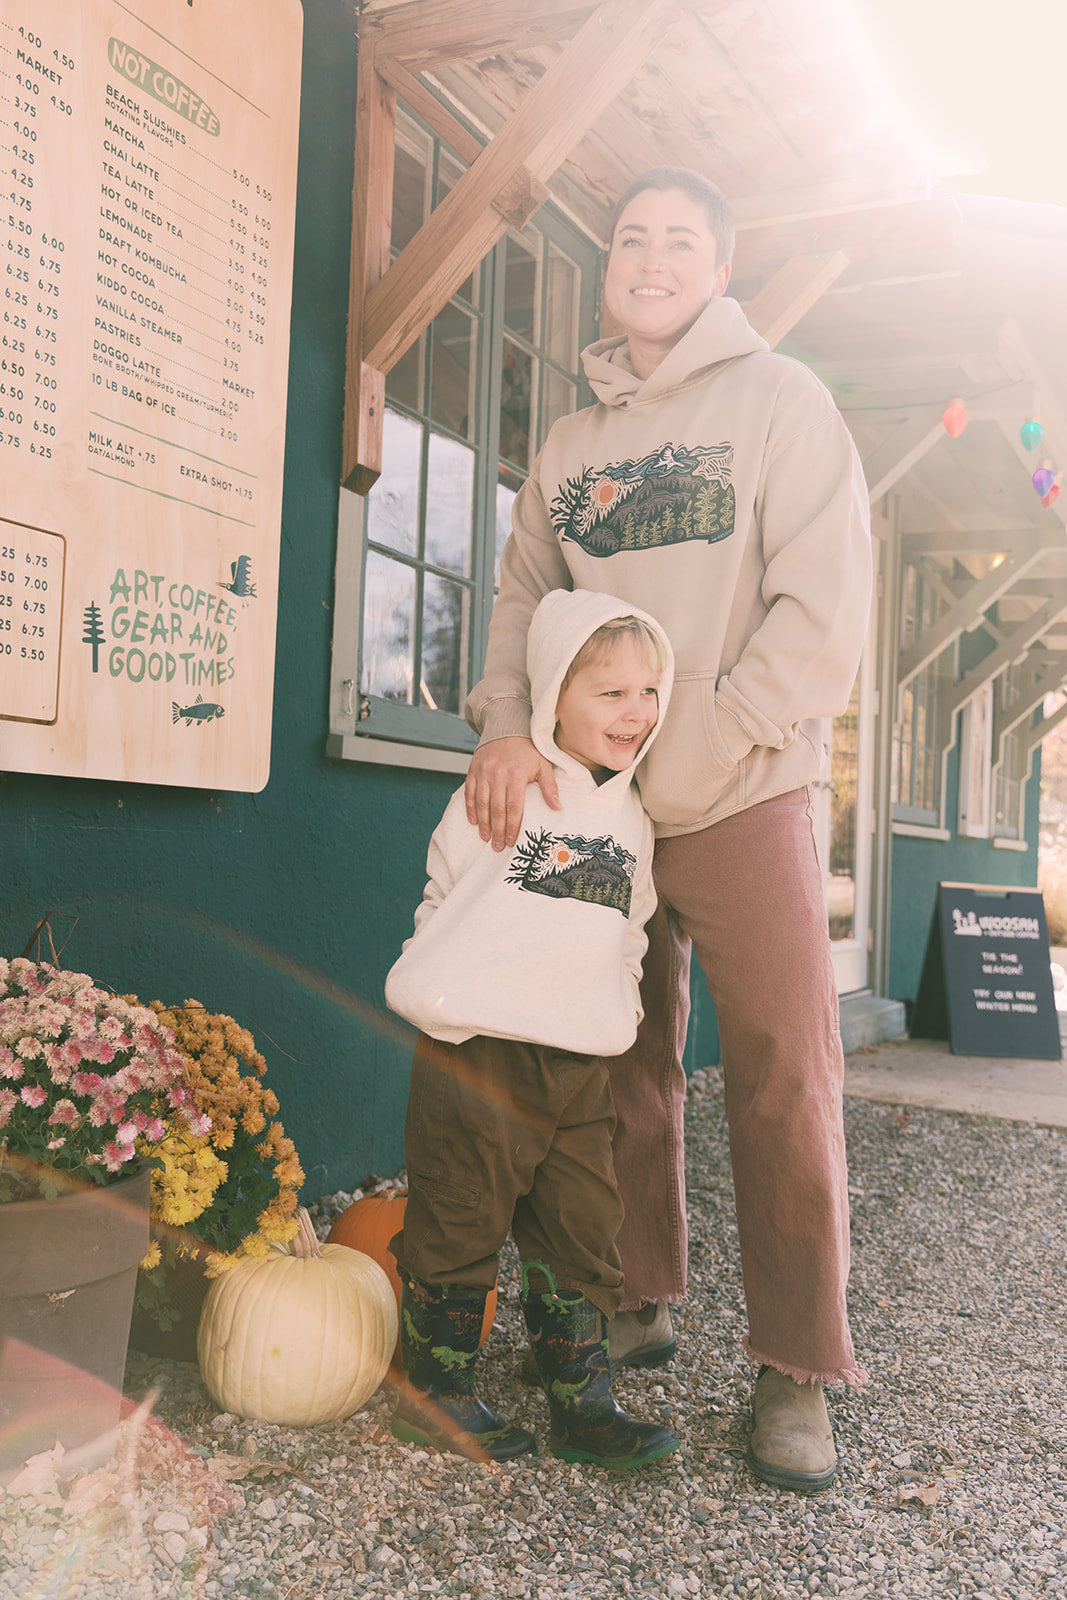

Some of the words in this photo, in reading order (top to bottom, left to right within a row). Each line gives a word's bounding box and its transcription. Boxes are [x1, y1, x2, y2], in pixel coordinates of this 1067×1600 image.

[18, 26, 42, 49] 4.00
[53, 49, 75, 70] 4.50
[16, 48, 63, 86] MARKET
[16, 74, 40, 95] 4.00
[50, 95, 73, 116] 4.50
[112, 40, 149, 84] NOT
[152, 72, 219, 136] COFFEE
[14, 96, 36, 118] 3.75
[105, 97, 141, 126] ROTATING
[143, 122, 174, 148] FLAVORS
[106, 84, 140, 114] BEACH
[143, 109, 186, 145] SLUSHIES
[13, 121, 37, 142] 4.00
[104, 117, 145, 151] MATCHA
[12, 145, 35, 165] 4.25
[103, 140, 128, 162] CHAI
[131, 156, 160, 182] LATTE
[11, 168, 34, 188] 4.25
[102, 161, 122, 181] TEA
[125, 175, 154, 201] LATTE
[10, 192, 32, 212] 4.75
[101, 183, 121, 203] HOT
[124, 198, 138, 213] OR
[141, 207, 163, 226] ICED
[166, 221, 183, 239] TEA
[8, 215, 32, 236] 5.50
[42, 233, 65, 252] 6.00
[100, 205, 153, 244] LEMONADE
[7, 239, 30, 259] 6.25
[39, 255, 61, 274] 6.75
[98, 250, 118, 268] HOT
[121, 263, 155, 289] COCOA
[99, 228, 132, 253] DRAFT
[135, 248, 187, 284] KOMBUCHA
[6, 263, 29, 283] 6.25
[38, 279, 60, 297] 6.75
[97, 272, 127, 296] KIDDO
[130, 290, 165, 315] COCOA
[5, 287, 28, 306] 6.25
[37, 302, 58, 320] 6.75
[95, 294, 137, 323] VANILLA
[140, 317, 183, 345] STEAMER
[3, 311, 27, 330] 6.25
[35, 325, 57, 343] 6.75
[2, 335, 25, 353] 6.25
[34, 349, 56, 366] 6.75
[92, 353, 113, 368] BONE
[93, 339, 129, 363] DOGGO
[132, 357, 161, 378] LATTE
[94, 317, 141, 347] PASTRIES
[222, 377, 255, 400] MARKET
[1, 359, 25, 377] 6.50
[35, 372, 57, 390] 7.00
[0, 383, 24, 401] 6.50
[34, 395, 56, 413] 7.00
[92, 373, 102, 385] 10
[106, 379, 118, 392] LB
[121, 385, 143, 402] BAG
[145, 396, 158, 408] OF
[161, 402, 176, 417] ICE
[0, 407, 23, 425] 6.00
[33, 420, 56, 437] 6.50
[30, 442, 52, 459] 6.25
[88, 445, 135, 468] OAT/ALMOND
[89, 431, 112, 449] MILK
[116, 442, 134, 456] ALT
[180, 465, 208, 484] EXTRA
[210, 476, 232, 492] SHOT
[25, 553, 48, 568] 6.75
[24, 576, 48, 591] 7.00
[109, 568, 165, 608] ART,
[168, 583, 237, 633] COFFEE,
[23, 600, 46, 614] 6.75
[22, 623, 45, 638] 6.75
[111, 606, 183, 645] GEAR
[189, 622, 228, 655] AND
[20, 647, 45, 661] 5.50
[109, 646, 177, 683] GOOD
[179, 652, 235, 687] TIMES
[1000, 953, 1018, 963] THE
